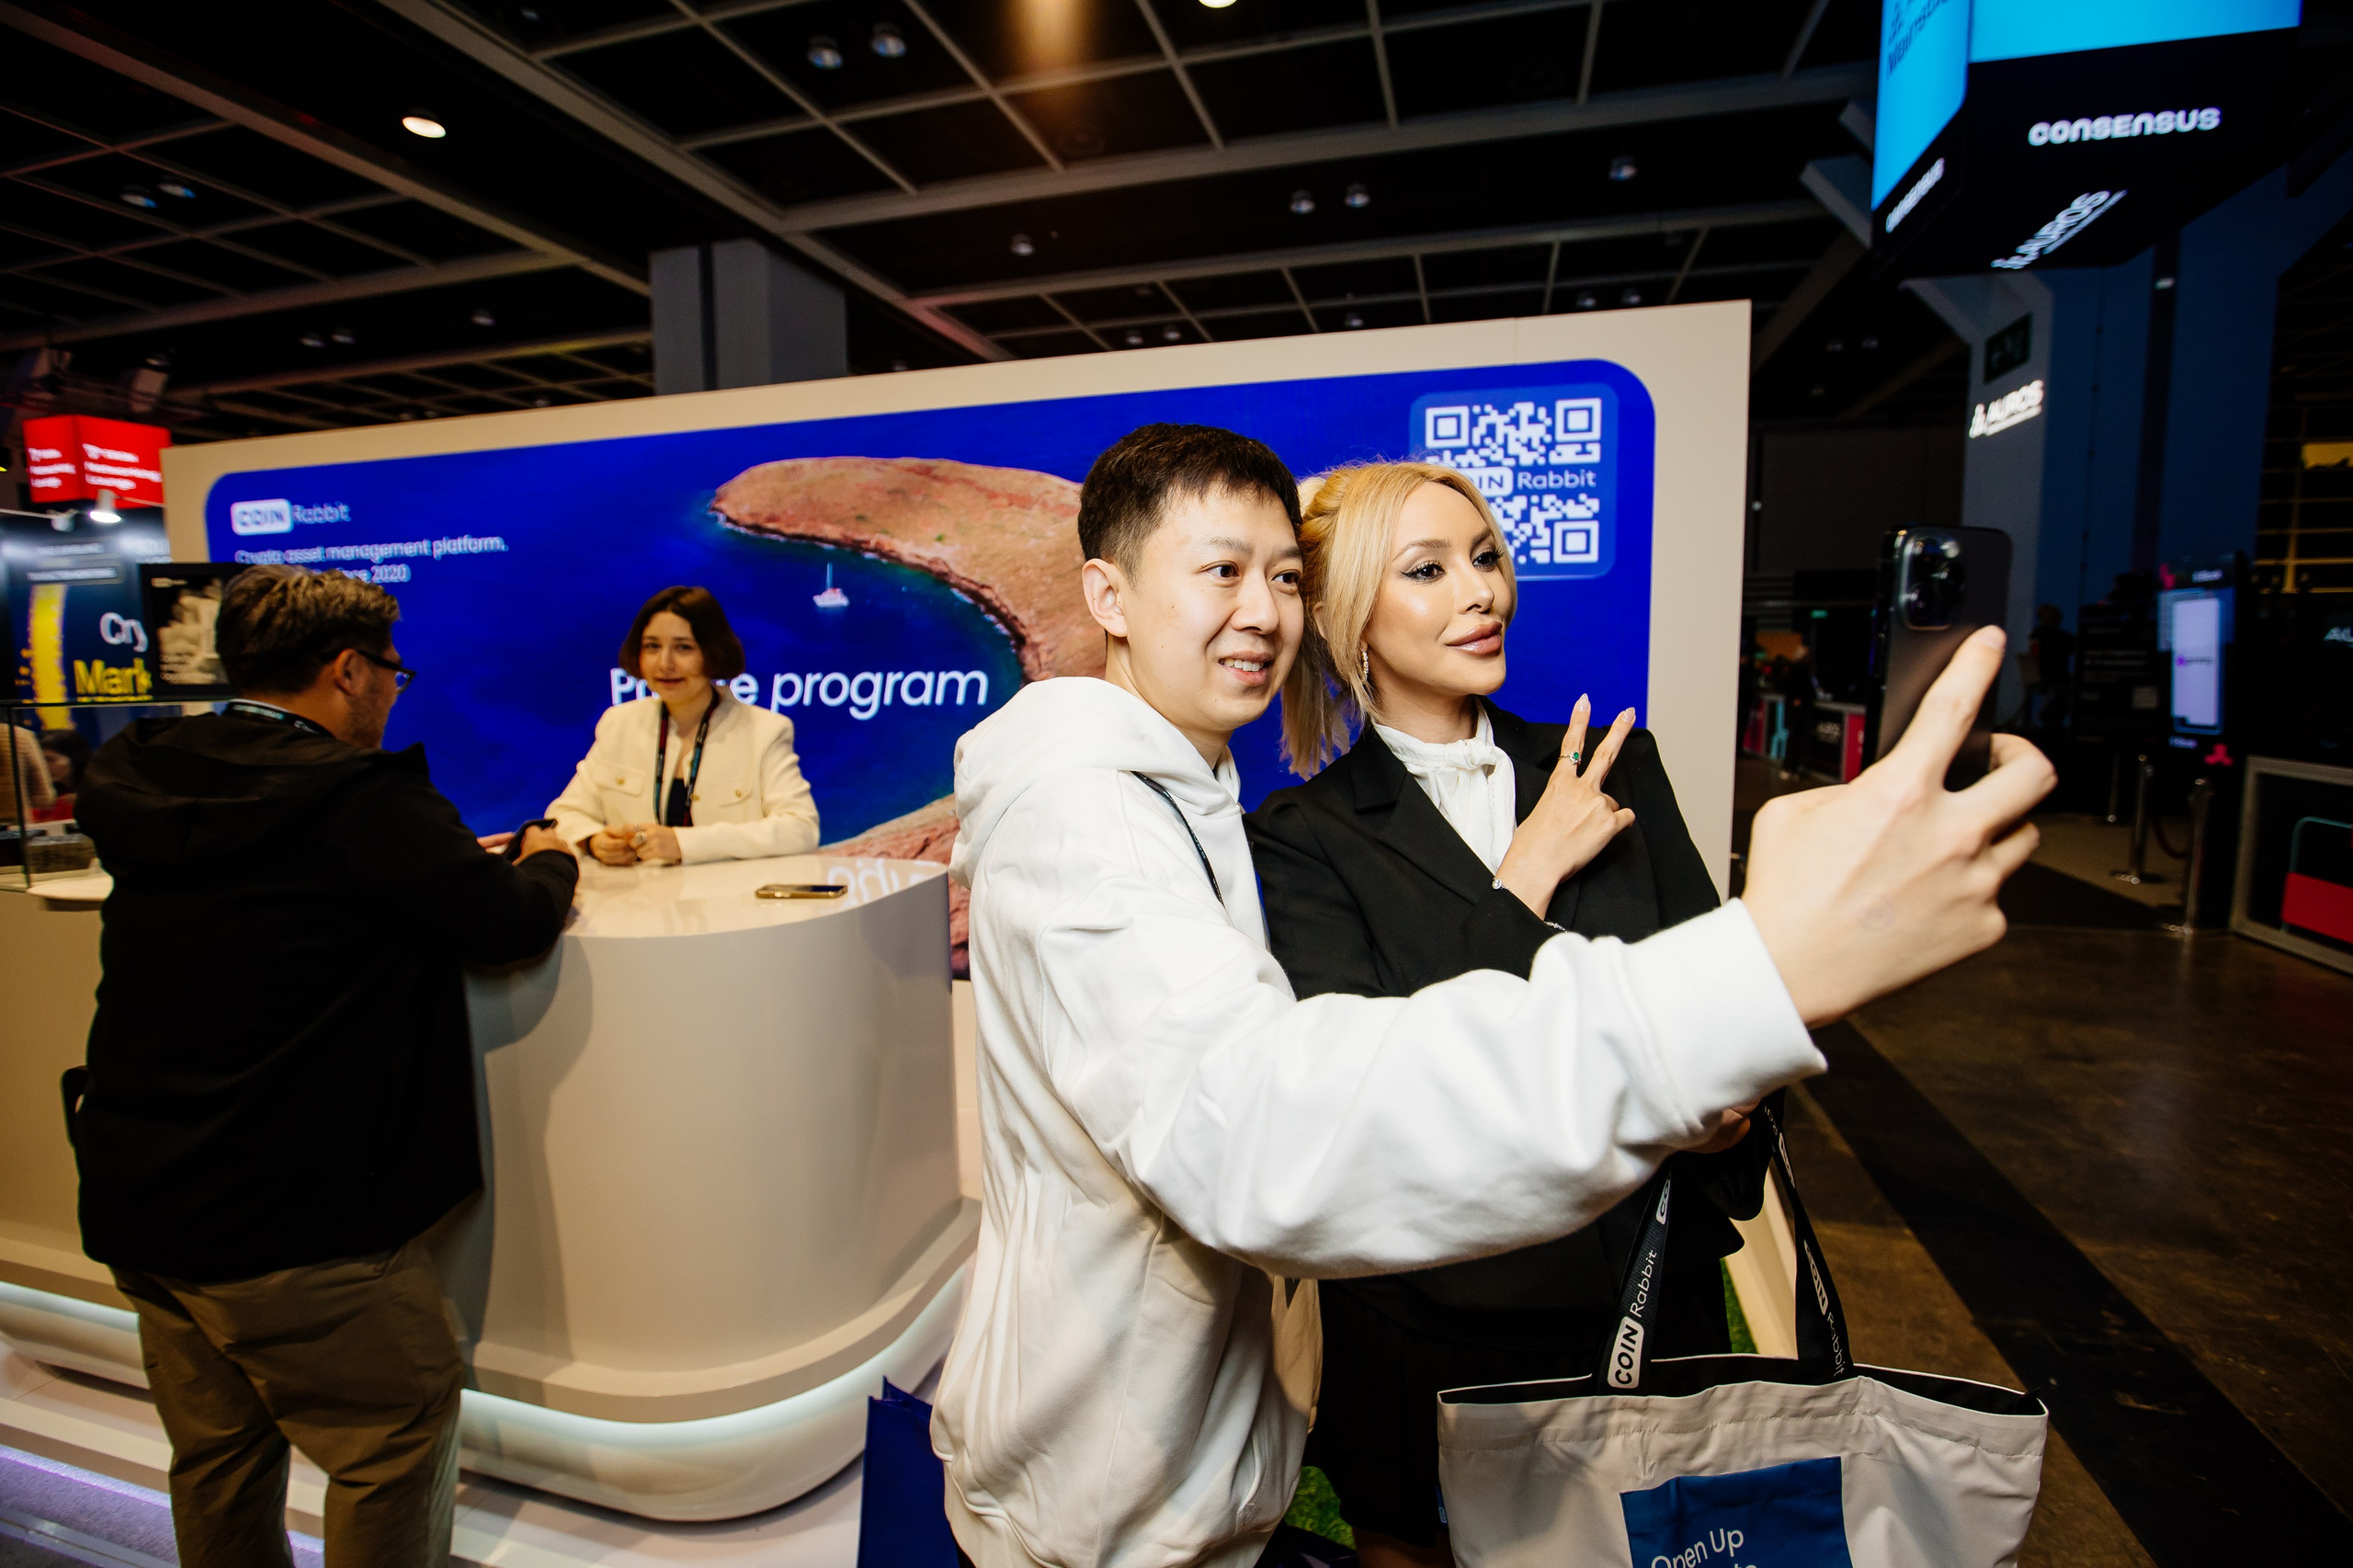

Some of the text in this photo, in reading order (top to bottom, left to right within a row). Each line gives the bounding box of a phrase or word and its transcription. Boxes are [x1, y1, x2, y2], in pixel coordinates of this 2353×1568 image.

[2028, 107, 2222, 146] CONSENSUS
[1517, 469, 1597, 490] Rabbit
[238, 502, 351, 528] COIN Rabbit
[284, 545, 325, 563] asset
[325, 539, 432, 563] management
[432, 534, 509, 561] platform.
[371, 563, 411, 584] 2020
[770, 670, 989, 721] program
[1614, 1249, 1658, 1385] COIN Rabbit
[1710, 1528, 1745, 1557] Up
